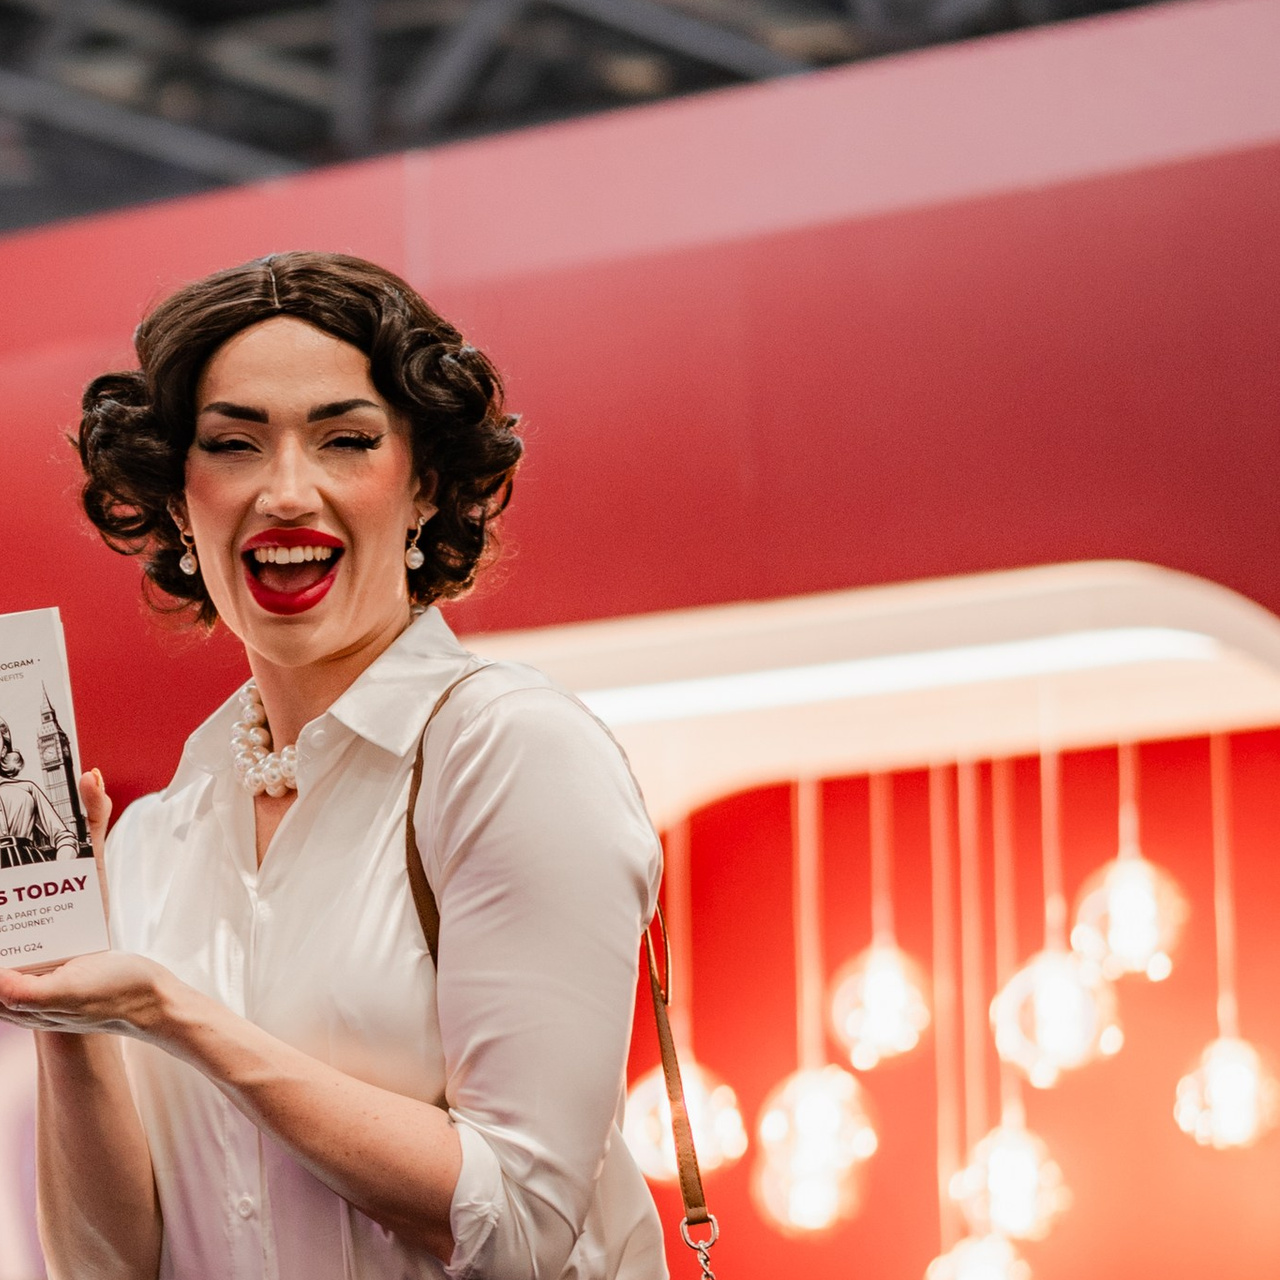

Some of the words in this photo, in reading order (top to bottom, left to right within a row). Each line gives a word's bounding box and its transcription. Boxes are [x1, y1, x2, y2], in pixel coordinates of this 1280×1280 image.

[13, 875, 88, 902] TODAY
[6, 913, 14, 922] A
[14, 909, 38, 920] PART
[39, 907, 52, 915] OF
[54, 902, 74, 913] OUR
[9, 916, 55, 931] JOURNEY!
[23, 941, 43, 953] G24
